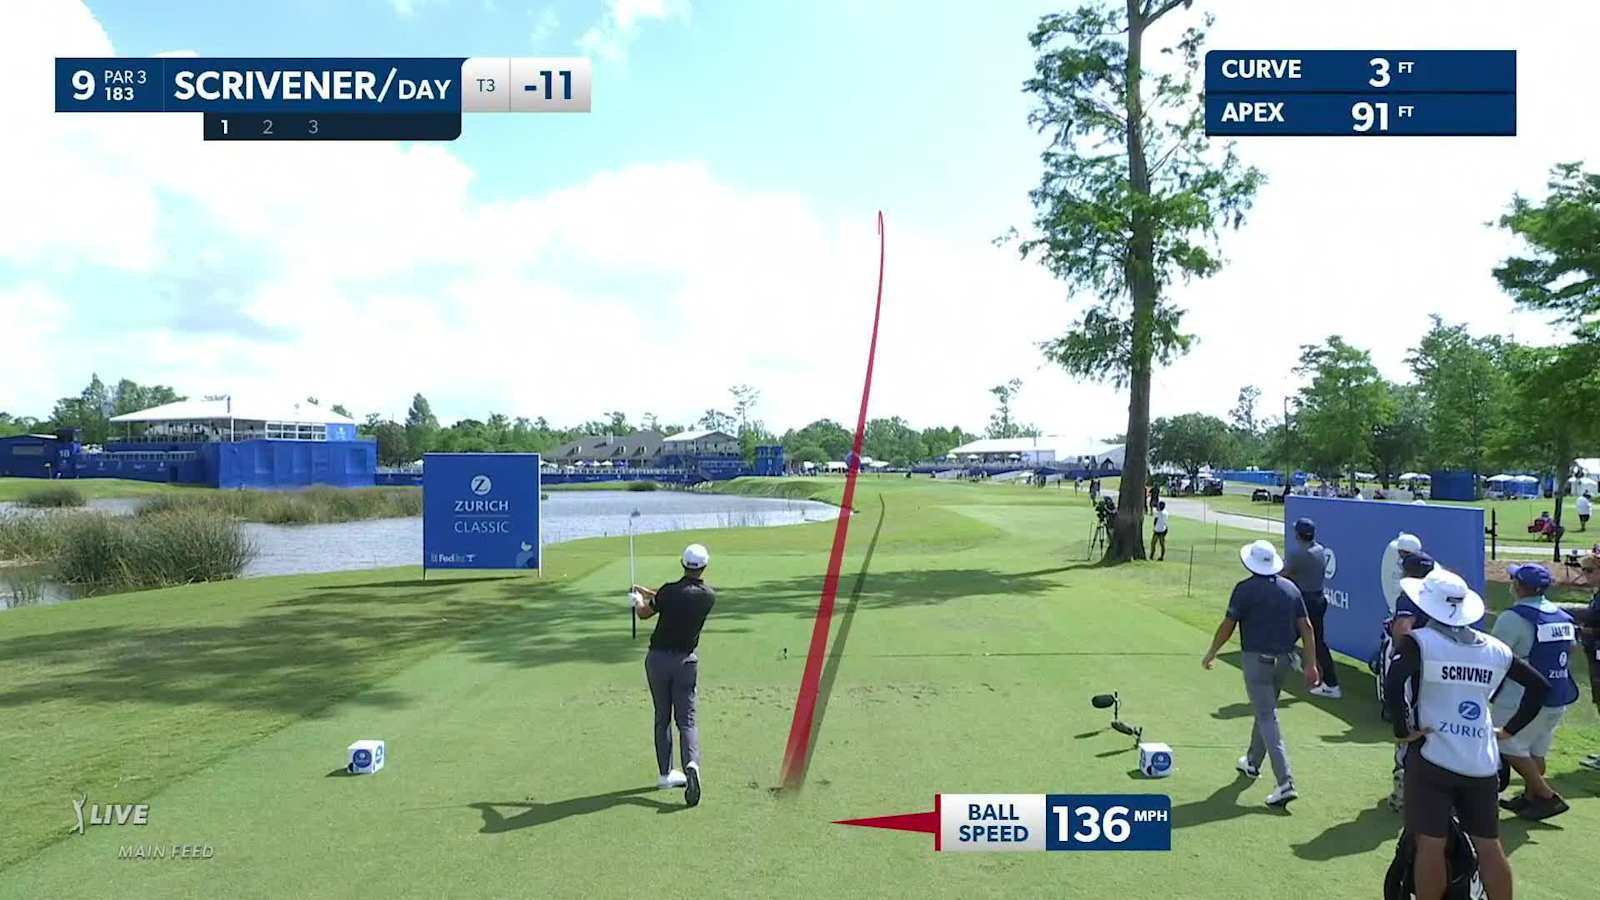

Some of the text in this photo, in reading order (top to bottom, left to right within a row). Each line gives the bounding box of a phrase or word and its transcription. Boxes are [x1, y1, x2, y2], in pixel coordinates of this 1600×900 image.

[454, 500, 509, 512] ZURICH
[454, 521, 509, 533] CLASSIC
[1440, 721, 1485, 737] ZURIC
